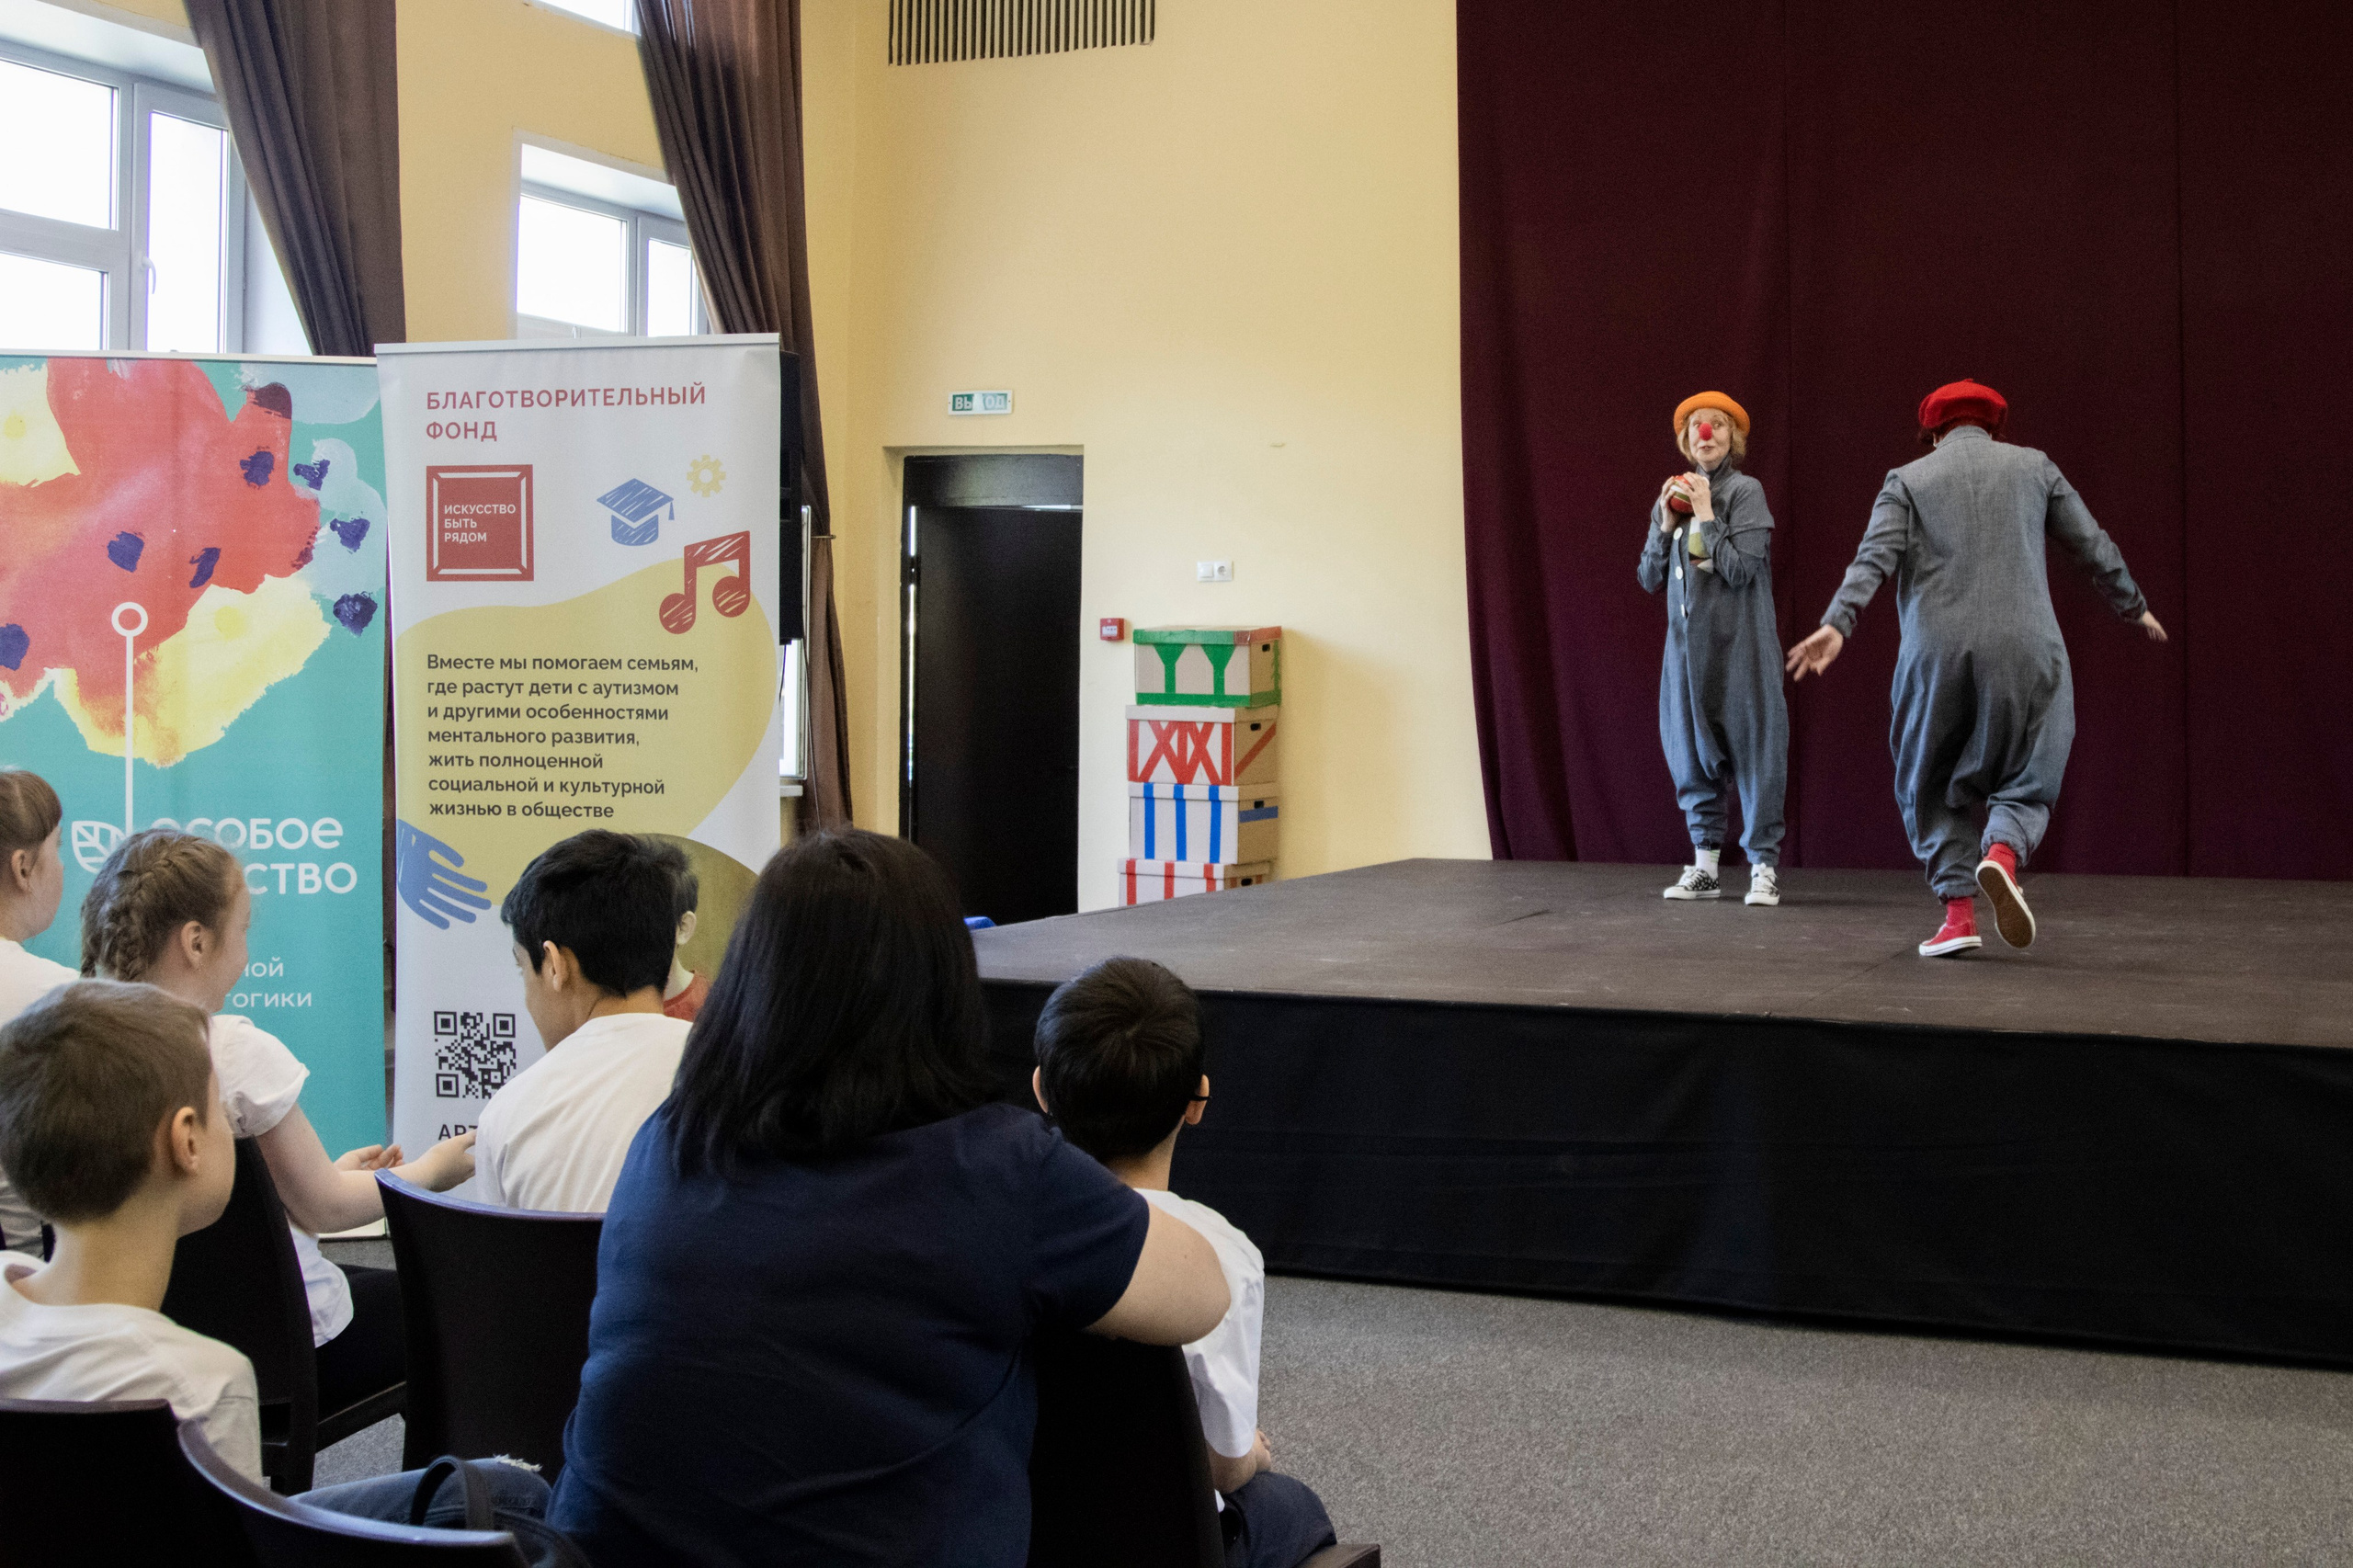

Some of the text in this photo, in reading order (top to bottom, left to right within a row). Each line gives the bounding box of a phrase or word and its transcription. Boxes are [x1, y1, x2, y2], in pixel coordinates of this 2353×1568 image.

[426, 381, 705, 410] БЛАГОТВОРИТЕЛЬНЫЙ
[426, 421, 497, 442] ФОНД
[444, 504, 517, 515] ИСКУССТВО
[444, 517, 478, 528] БЫТЬ
[444, 532, 487, 544] РЯДОМ
[427, 653, 699, 673] Вместе мы помогаем семьям,
[427, 682, 678, 699] где растут дети с аутизмом
[427, 703, 668, 722] и другими особенностями
[427, 731, 640, 748] ментального развития,
[428, 753, 603, 770] жить полноценной
[428, 777, 665, 798] социальной и культурной
[429, 801, 614, 820] жизнью в обществе
[245, 862, 358, 894] СТВО
